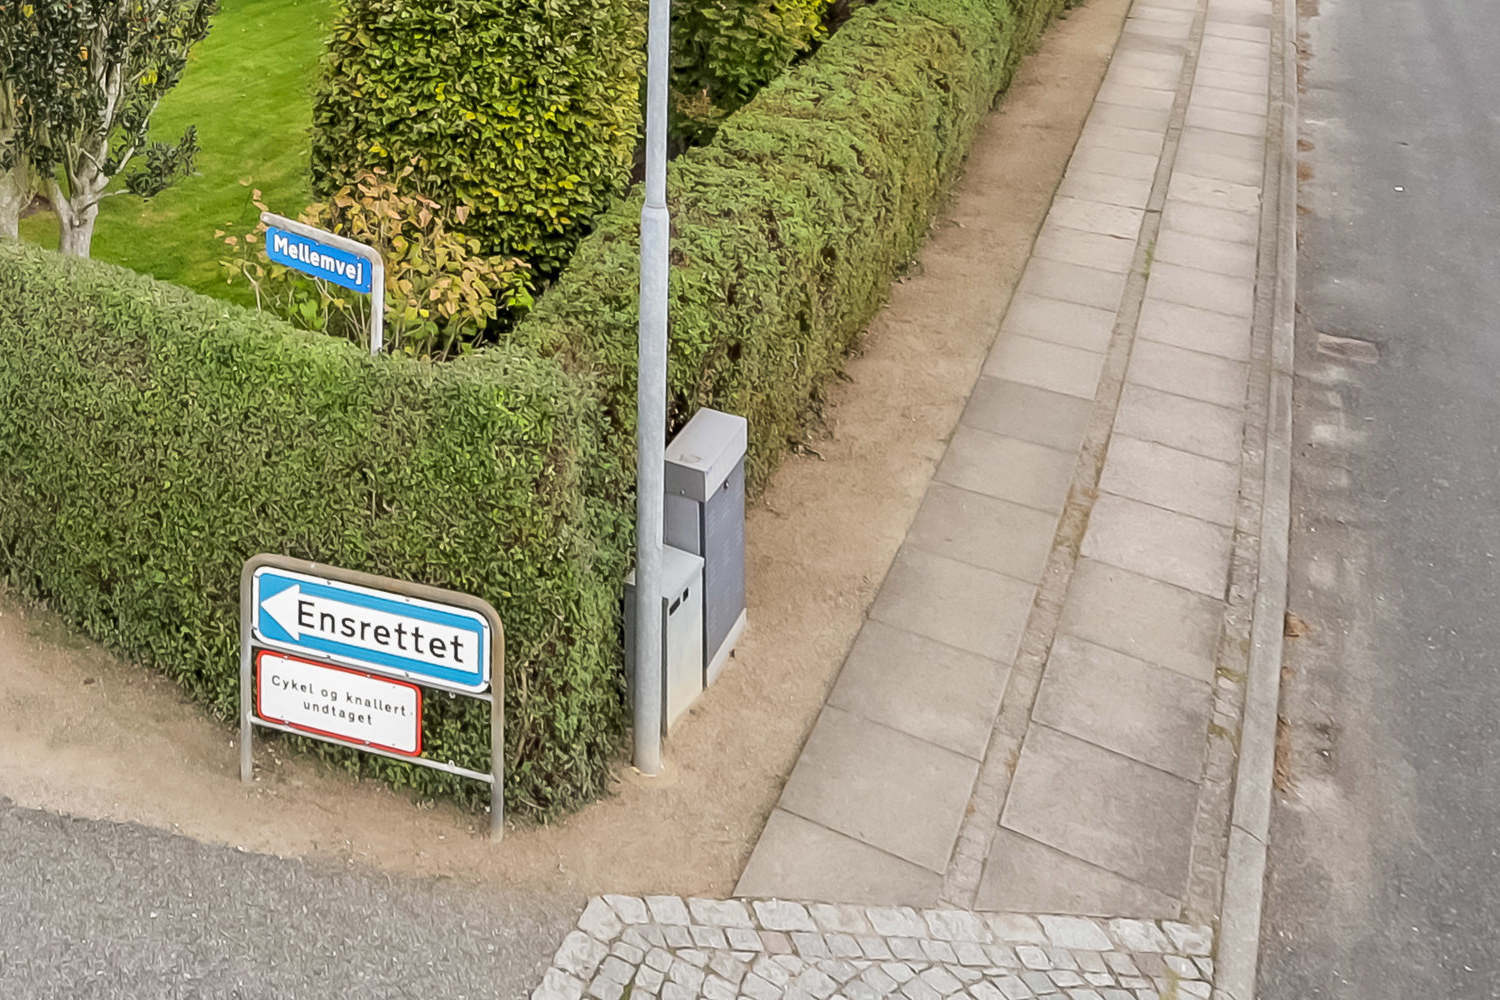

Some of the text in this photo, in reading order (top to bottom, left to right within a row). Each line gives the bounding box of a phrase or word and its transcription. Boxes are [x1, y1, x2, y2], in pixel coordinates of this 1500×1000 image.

[273, 234, 362, 285] Mellemvej
[297, 599, 464, 663] Ensrettet
[271, 675, 407, 717] Cykel og knallert
[303, 701, 373, 726] undtaget
